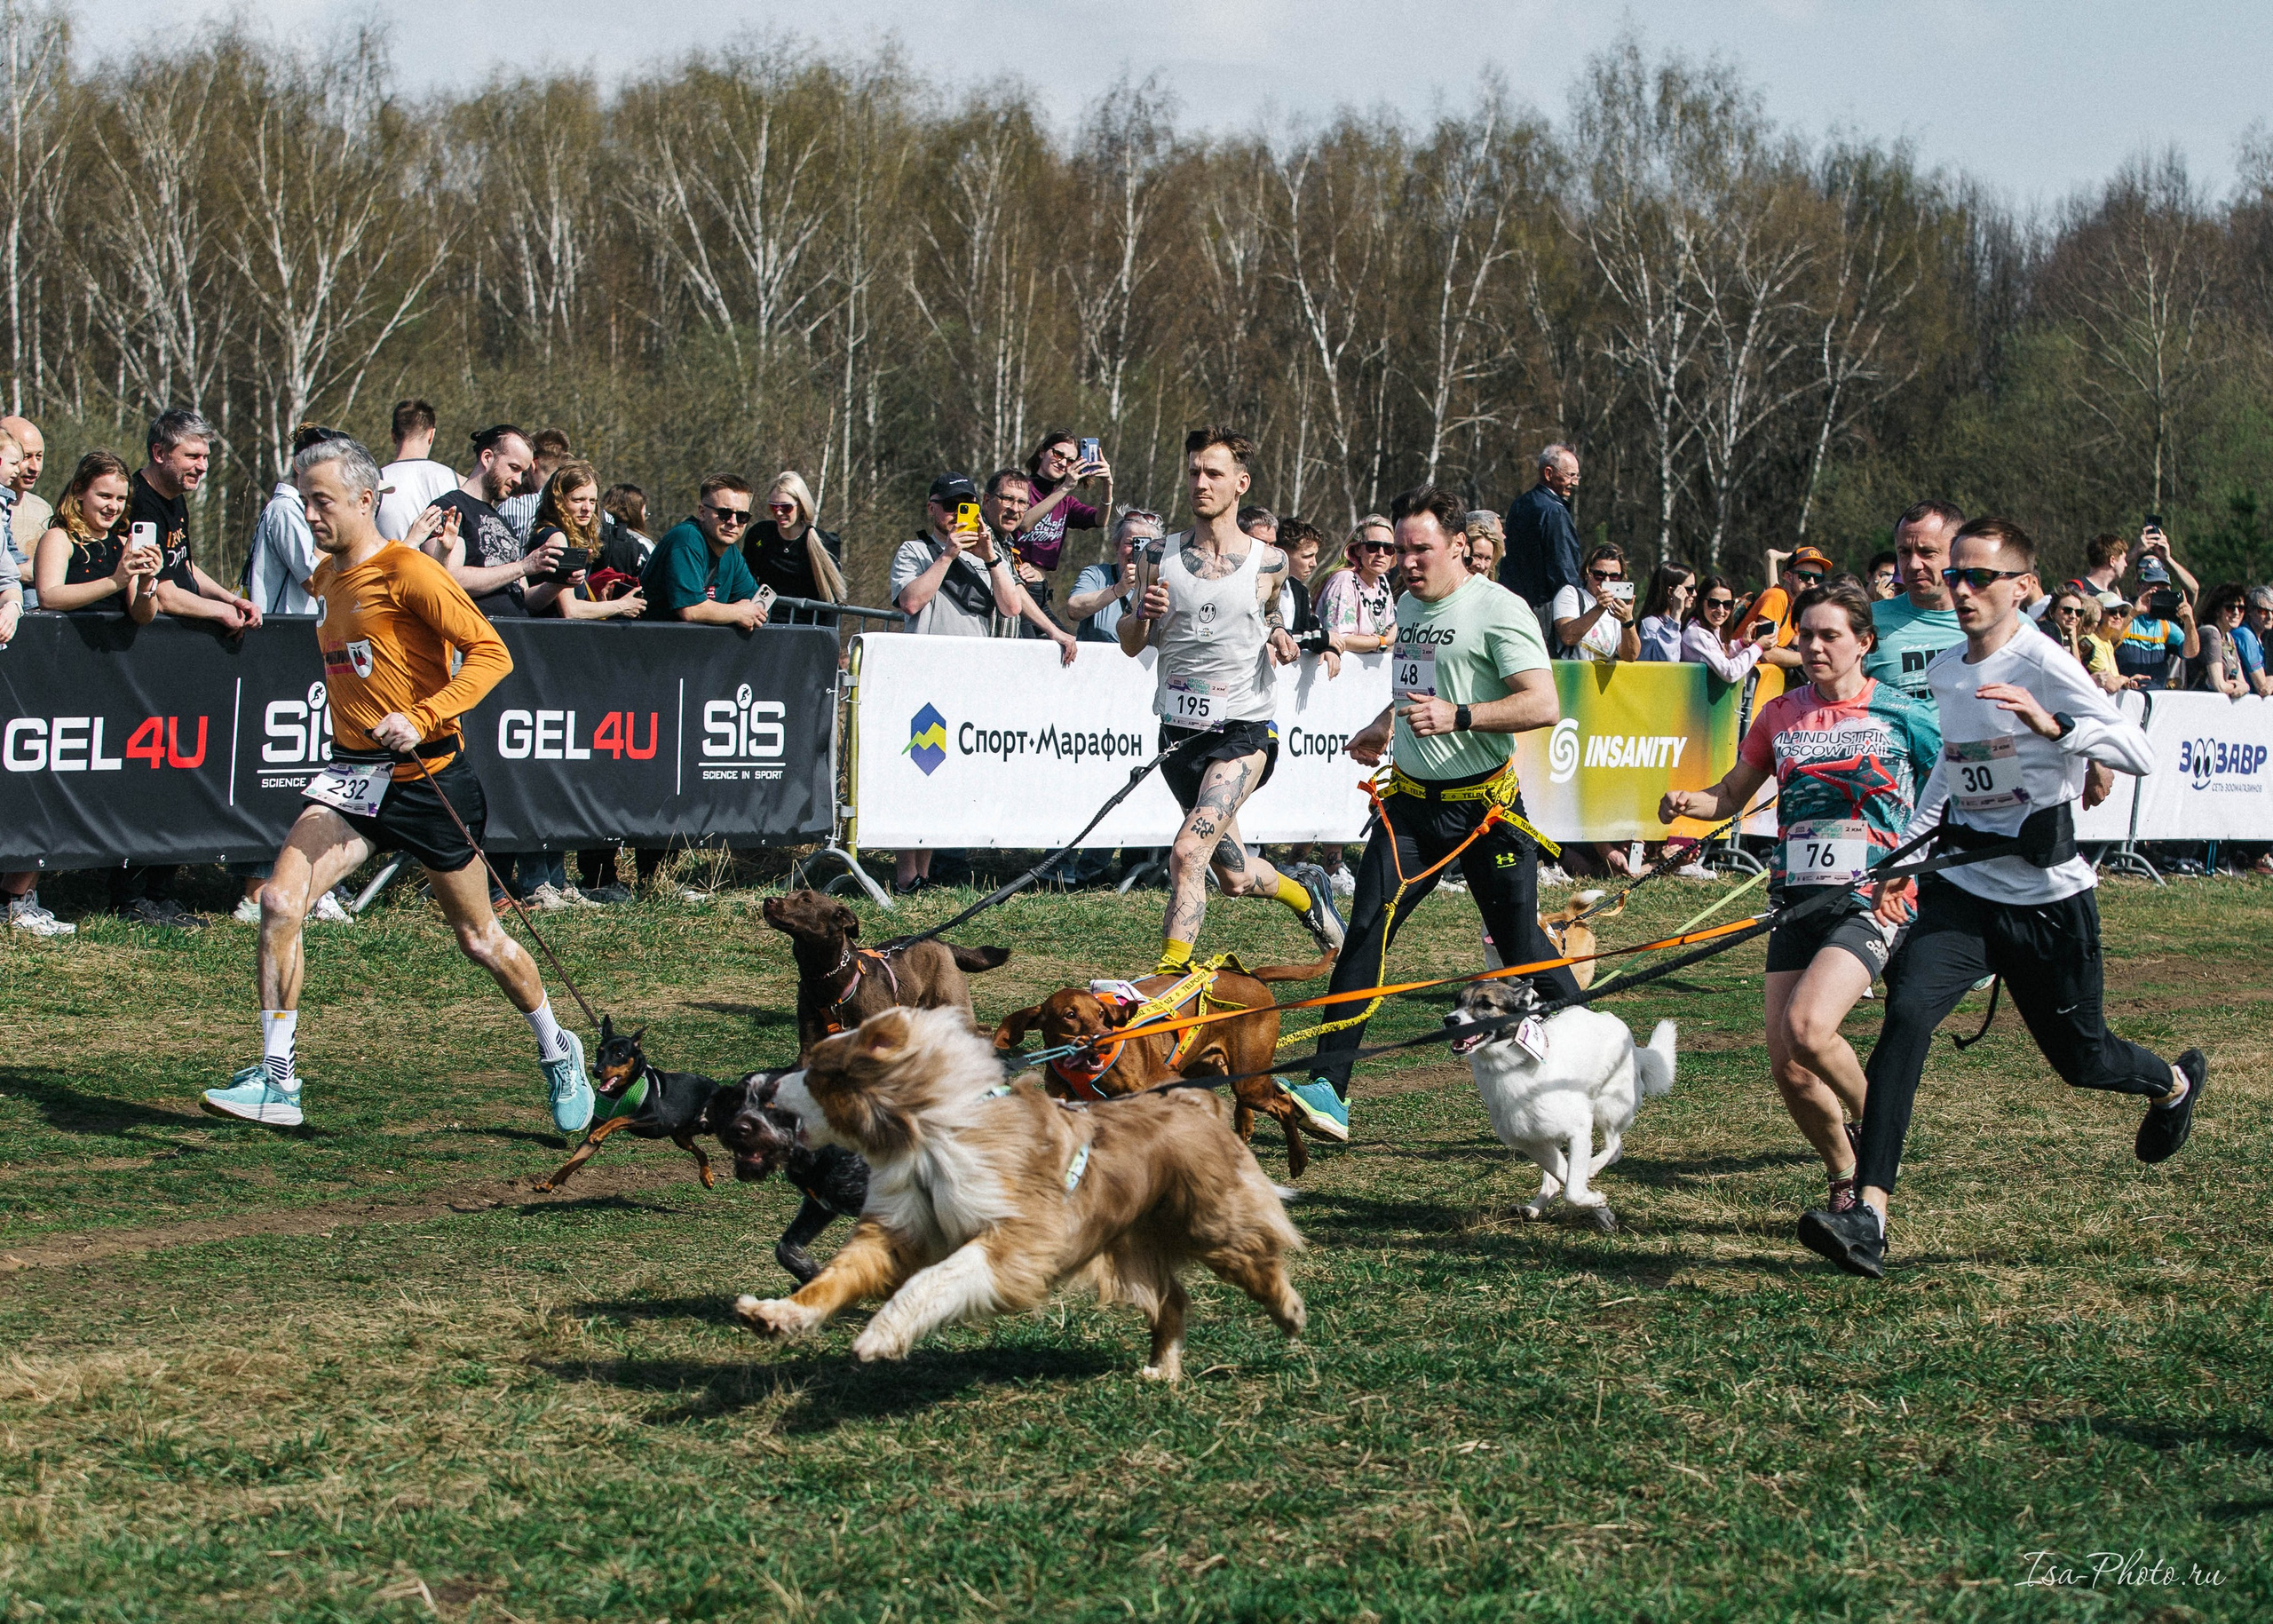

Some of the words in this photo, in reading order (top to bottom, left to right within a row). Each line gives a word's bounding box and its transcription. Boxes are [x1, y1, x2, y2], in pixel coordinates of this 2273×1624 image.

[1400, 663, 1418, 685] 48
[1177, 694, 1210, 717] 195
[262, 681, 334, 763] Si
[4, 716, 208, 772] GEL4U
[497, 709, 658, 760] GEL4U
[1583, 735, 1688, 768] INSANITY
[261, 777, 307, 788] SCIENCE
[702, 770, 739, 780] SCIENCE
[741, 770, 750, 780] IN
[754, 770, 783, 780] SPORT
[1960, 765, 1994, 793] 30
[327, 779, 369, 800] 232
[1806, 843, 1835, 868] 76
[1181, 970, 1208, 993] TELPOSIZ
